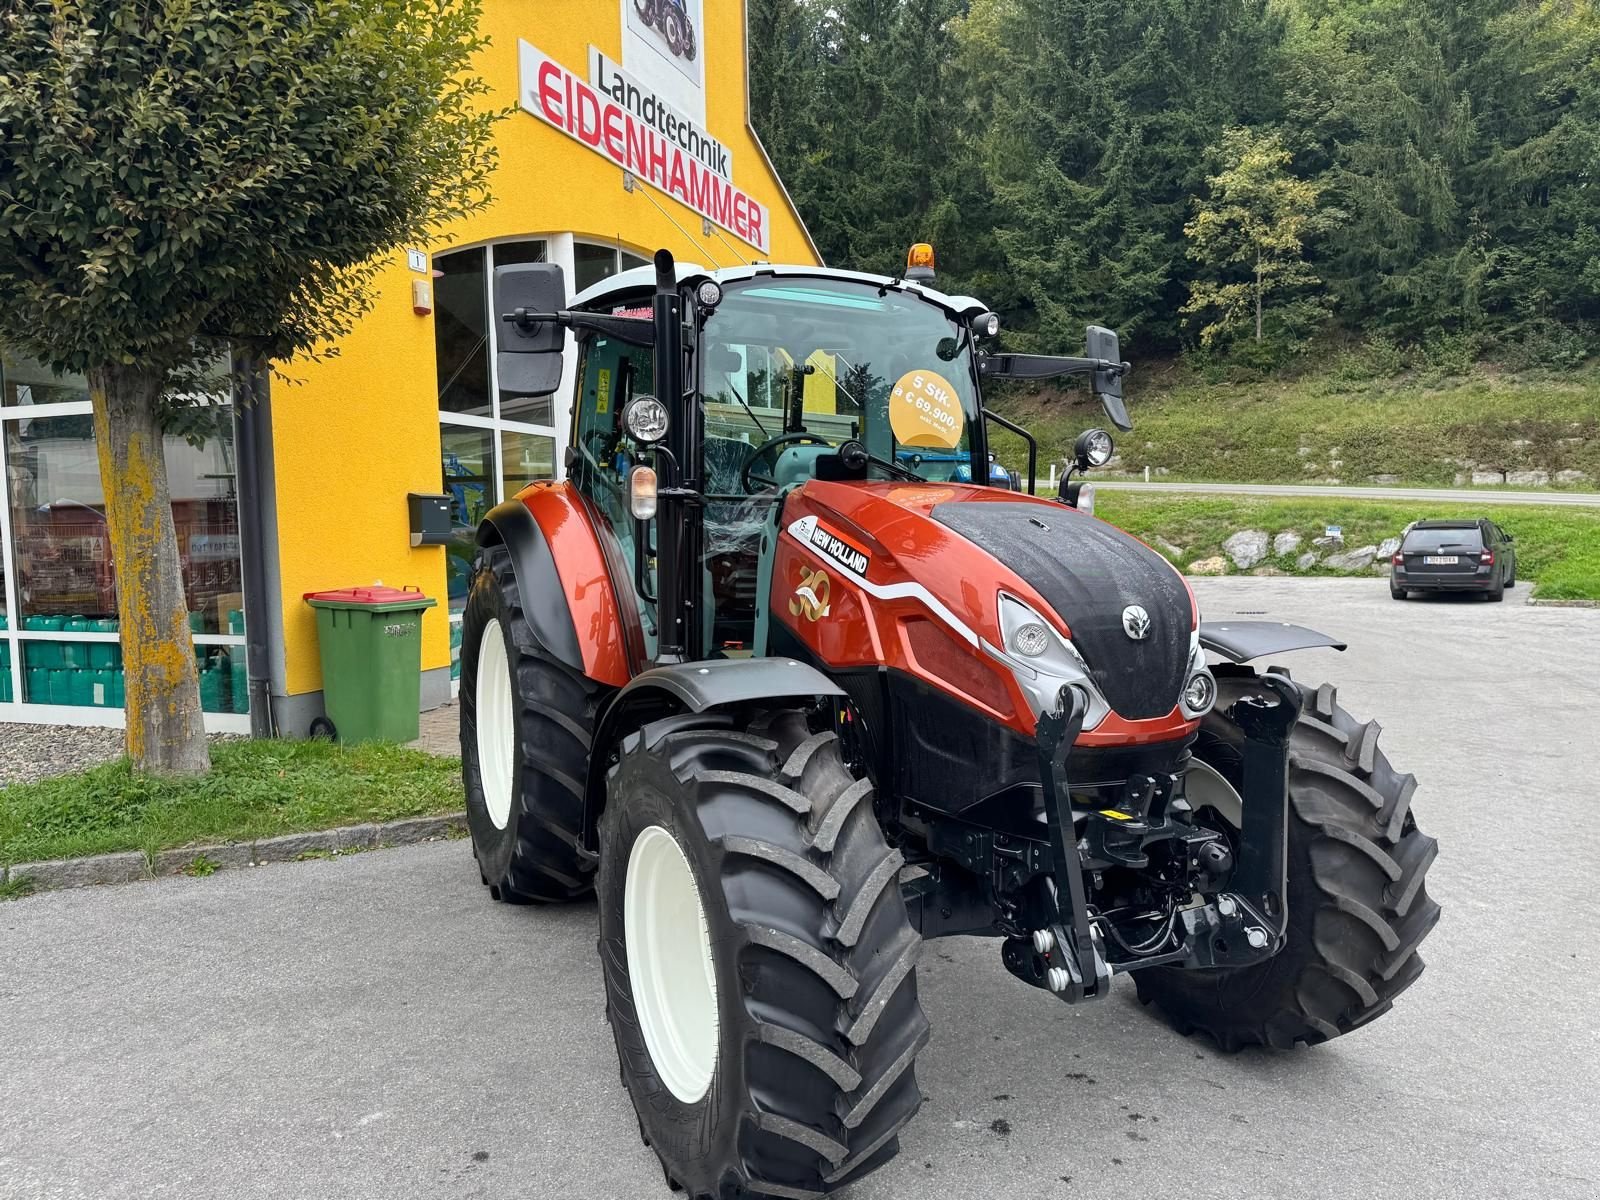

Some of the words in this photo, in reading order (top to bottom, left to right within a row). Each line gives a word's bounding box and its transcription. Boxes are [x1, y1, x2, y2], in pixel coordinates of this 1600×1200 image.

[598, 53, 728, 178] Landtechnik
[538, 61, 762, 247] EIDENHAMMER
[905, 391, 915, 403] €
[913, 376, 923, 388] 5
[925, 383, 950, 407] Stk.
[811, 527, 829, 550] NEW
[827, 538, 867, 573] HOLLAND
